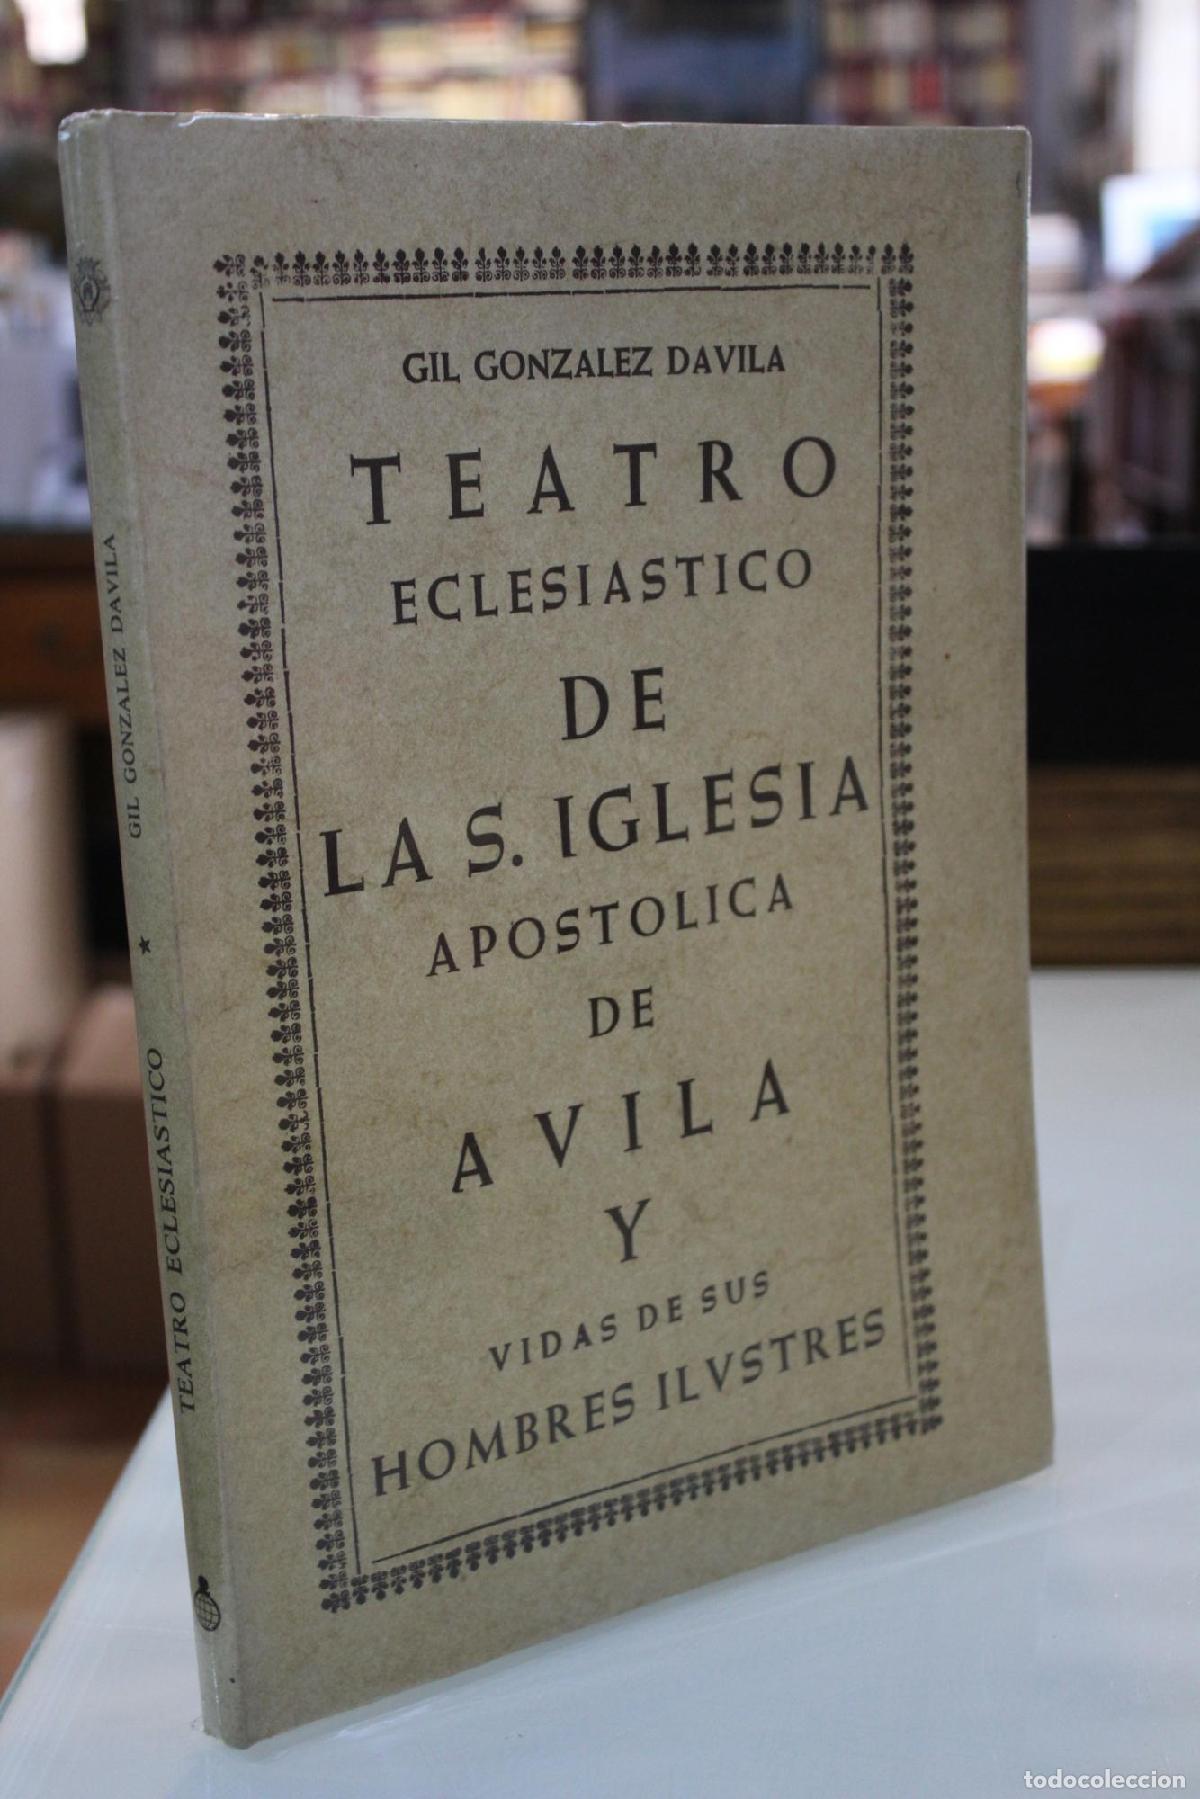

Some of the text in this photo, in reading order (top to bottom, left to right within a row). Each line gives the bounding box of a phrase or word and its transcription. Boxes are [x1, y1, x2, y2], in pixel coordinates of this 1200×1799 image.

[403, 345, 785, 383] GIL GONZALEZ DAVILA
[350, 437, 835, 525] TEATRO
[391, 549, 811, 625] ECLESIASTICO
[103, 532, 142, 839] GIL GONZALEZ DAVILA
[560, 667, 665, 740] DE
[320, 755, 867, 896] LA S. IGLESIA
[426, 874, 792, 977] APOSTOLICA
[589, 986, 653, 1038] DE
[452, 1059, 789, 1193] AVILA
[146, 1046, 195, 1415] TEATRO ECLESIASTICO
[604, 1198, 650, 1262] Y
[488, 1270, 770, 1371] VIDAS DE SUS
[372, 1307, 886, 1496] HOMBRES ILVSTRES
